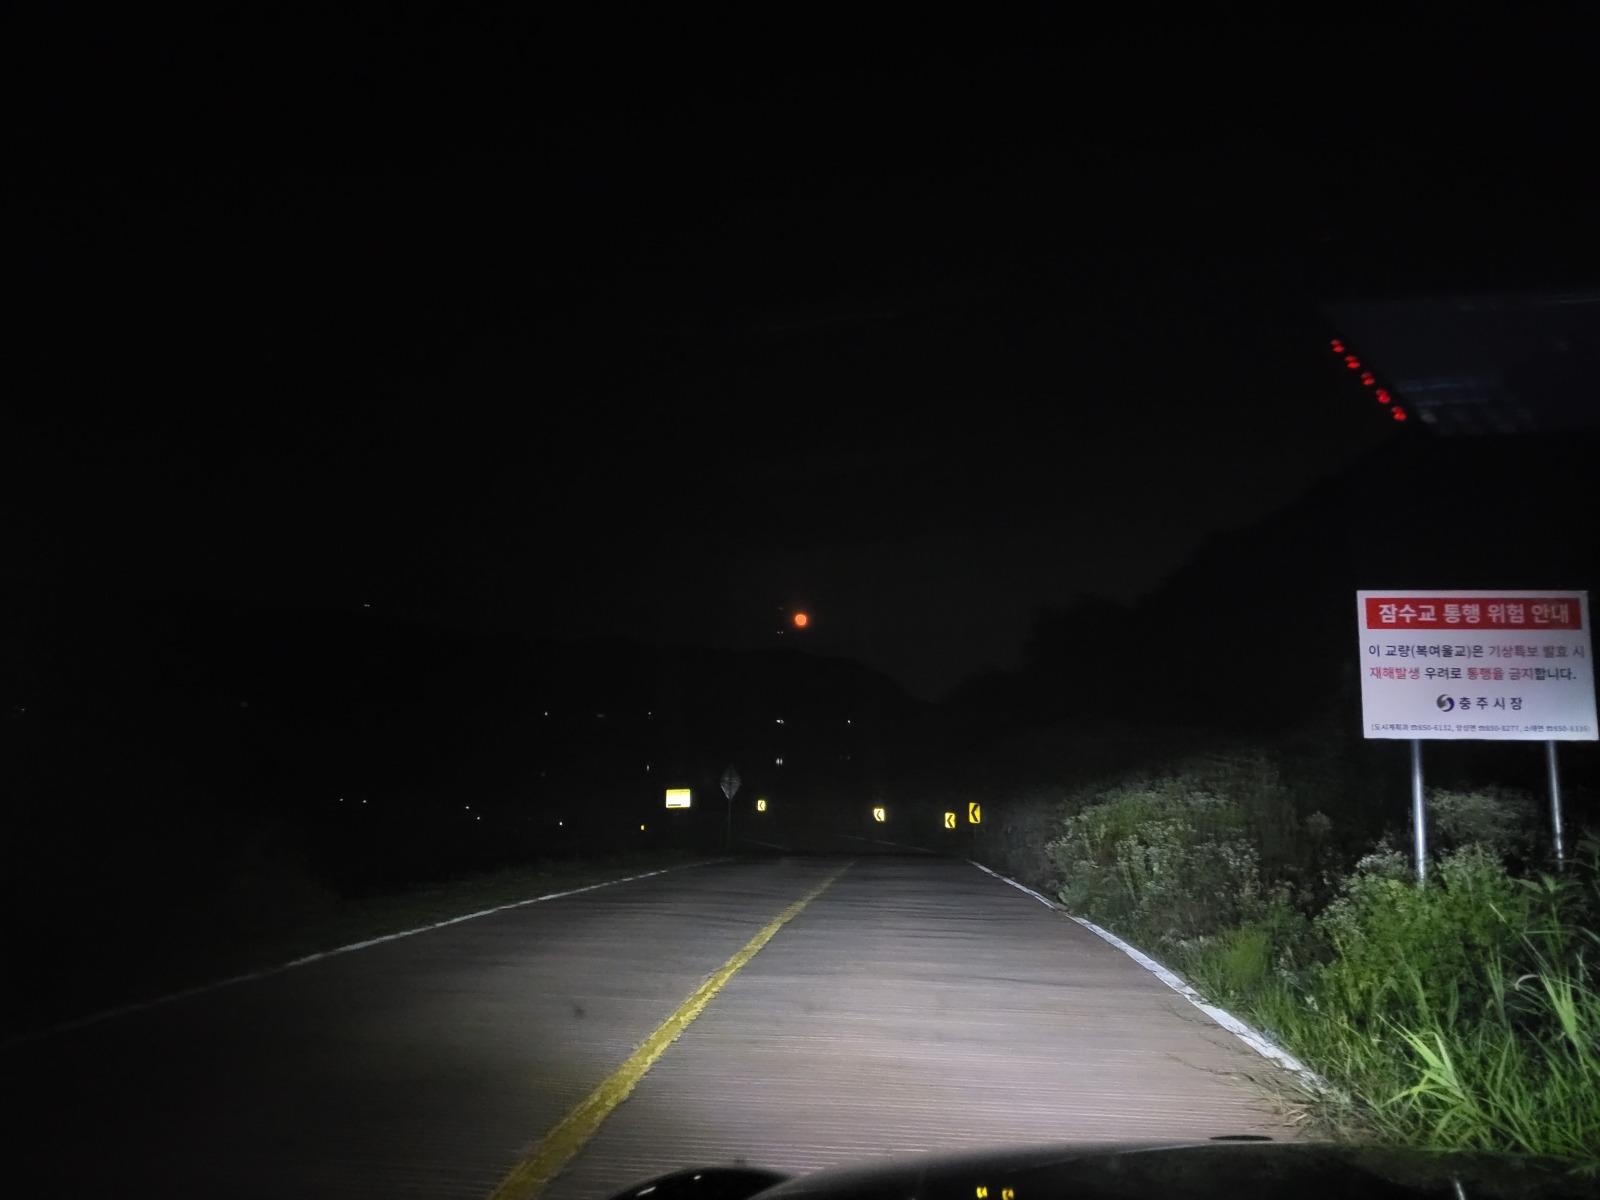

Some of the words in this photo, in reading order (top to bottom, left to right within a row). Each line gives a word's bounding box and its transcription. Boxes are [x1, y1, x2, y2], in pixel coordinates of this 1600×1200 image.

[1379, 603, 1437, 624] 잠수교
[1443, 603, 1481, 624] 통행
[1487, 603, 1525, 624] 위험
[1531, 603, 1570, 624] 안내
[1368, 645, 1381, 658] 이
[1488, 645, 1539, 658] 기상특보
[1543, 645, 1568, 658] 발효
[1573, 645, 1585, 658] 시
[1370, 667, 1420, 680] 재해발생
[1424, 667, 1462, 680] 우려로
[1467, 667, 1504, 681] 통행을
[1508, 667, 1577, 681] 금지합니다.
